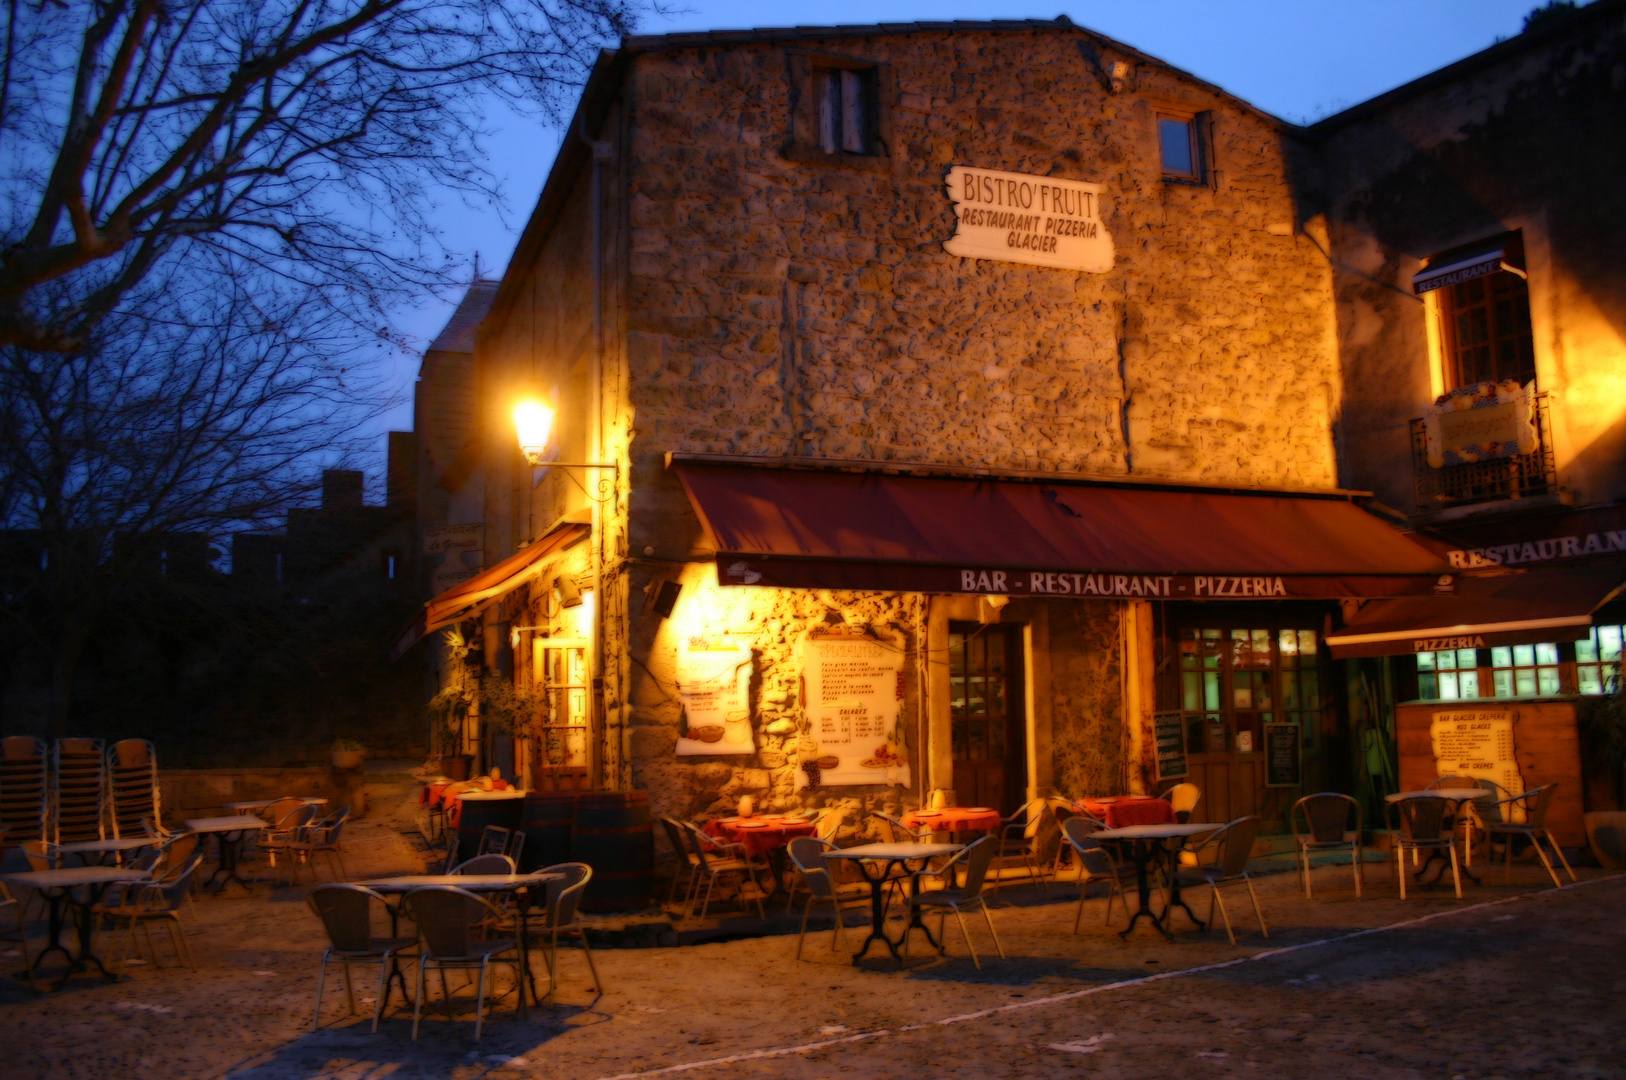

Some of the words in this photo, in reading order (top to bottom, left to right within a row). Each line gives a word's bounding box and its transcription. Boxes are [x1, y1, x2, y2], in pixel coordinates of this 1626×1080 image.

[962, 208, 1041, 232] RESTAURANT
[1045, 217, 1097, 239] PIZZERIA
[1007, 231, 1057, 253] GLACIER
[1418, 261, 1495, 293] RESTAURANT
[961, 569, 1008, 592] BAR
[1030, 572, 1172, 596] RESTAURANT
[1194, 576, 1287, 597] PIZZERIA
[1414, 636, 1485, 651] PIZZERIA
